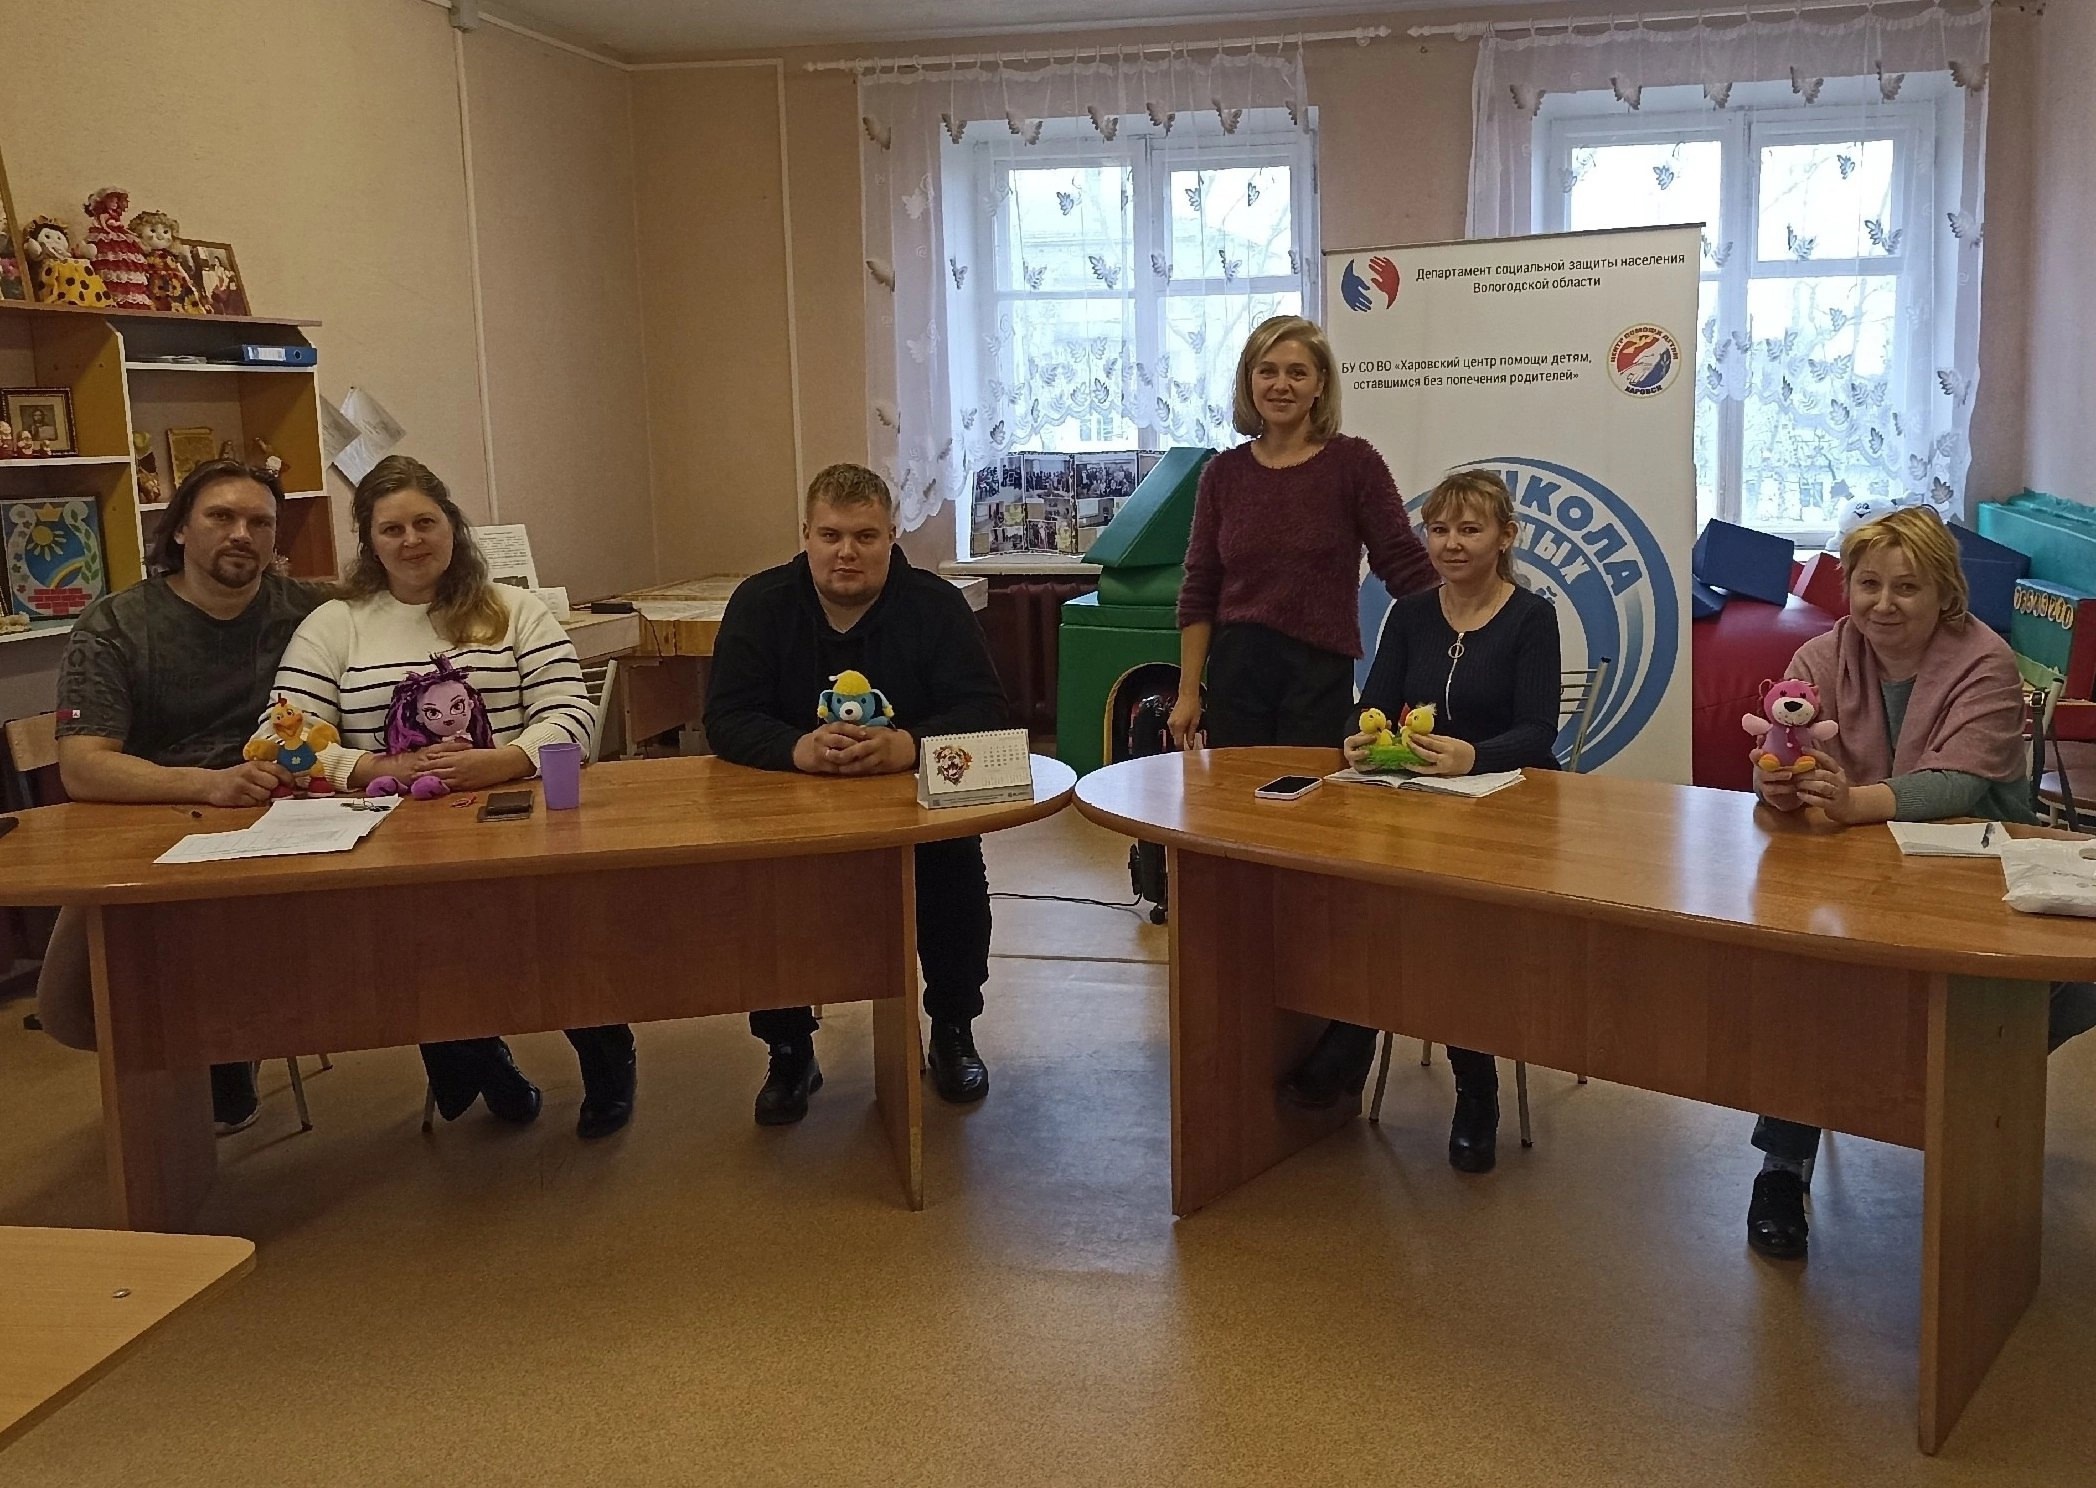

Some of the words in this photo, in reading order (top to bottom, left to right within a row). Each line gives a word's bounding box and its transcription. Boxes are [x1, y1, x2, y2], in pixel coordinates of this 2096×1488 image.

[1416, 266, 1491, 281] Департамент
[1496, 259, 1565, 276] социальной
[1569, 257, 1618, 270] защиты
[1621, 254, 1685, 266] населения
[1473, 277, 1549, 293] Вологодской
[1552, 277, 1600, 289] области
[1341, 362, 1356, 374] БУ
[1359, 361, 1375, 373] СО
[1377, 360, 1392, 372] ВО
[1395, 356, 1460, 372] «Харовский
[1463, 357, 1497, 369] центр
[1500, 355, 1548, 366] помощи
[1551, 353, 1592, 366] детям,
[1353, 377, 1421, 390] оставшимся
[1423, 375, 1443, 386] без
[1446, 374, 1507, 386] попечения
[1510, 369, 1579, 385] родителей»
